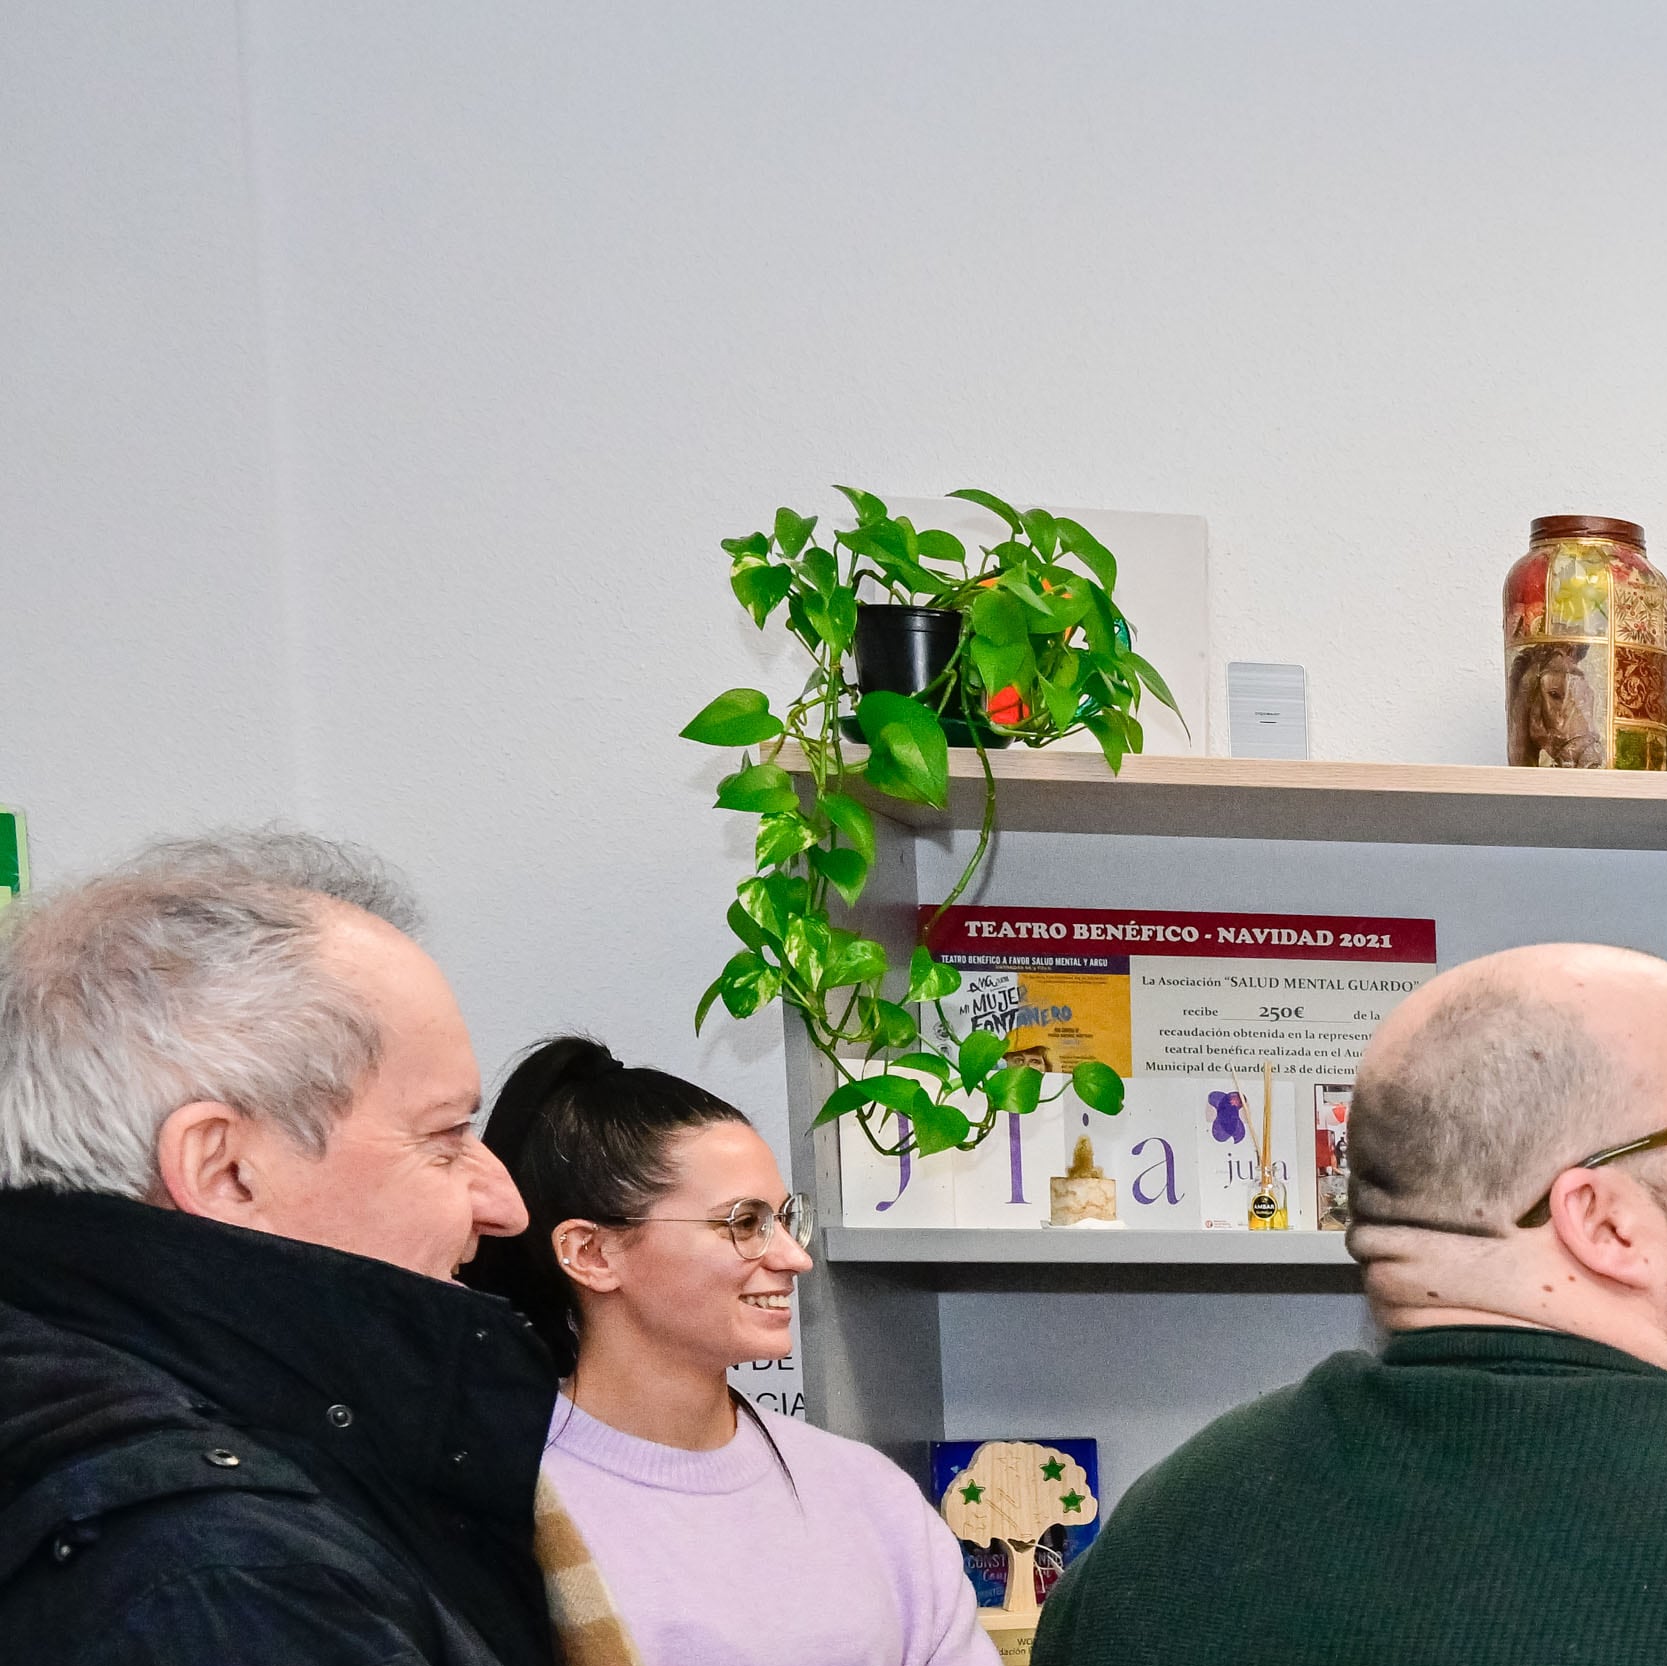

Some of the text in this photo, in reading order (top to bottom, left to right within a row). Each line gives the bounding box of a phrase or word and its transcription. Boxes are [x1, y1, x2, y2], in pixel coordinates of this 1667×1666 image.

[965, 920, 1067, 940] TEATRO
[1073, 920, 1199, 943] BENÉFICO
[1217, 926, 1333, 947] NAVIDAD
[1339, 932, 1393, 949] 2021
[941, 955, 967, 964] TEATRO
[968, 956, 1001, 965] BENÉFICO
[1002, 957, 1008, 965] A
[1008, 957, 1030, 966] FAVOR
[1031, 957, 1054, 966] SALUD
[1055, 958, 1082, 967] MENTAL
[1083, 958, 1088, 967] Y
[1142, 976, 1155, 986] La
[1159, 976, 1221, 988] Asociación
[1224, 976, 1279, 989] “SALUD
[1284, 978, 1345, 991] MENTAL
[973, 985, 1028, 1016] MUJER
[1183, 1006, 1381, 1022] recibe 250€ de la
[1159, 1027, 1231, 1038] recaudación
[1233, 1028, 1285, 1039] obtenida
[1287, 1032, 1302, 1040] en
[1305, 1030, 1315, 1040] la
[1165, 1044, 1203, 1055] teatral
[1206, 1045, 1256, 1056] benéfica
[1258, 1046, 1312, 1057] realizada
[1314, 1049, 1329, 1057] en
[1331, 1048, 1341, 1058] el
[1145, 1061, 1205, 1074] Municipal
[1207, 1062, 1222, 1072] de
[1271, 1064, 1281, 1073] el
[1283, 1064, 1297, 1074] 28
[1299, 1064, 1313, 1074] de
[1315, 1064, 1358, 1075] diciem
[999, 1647, 1026, 1656] dación
